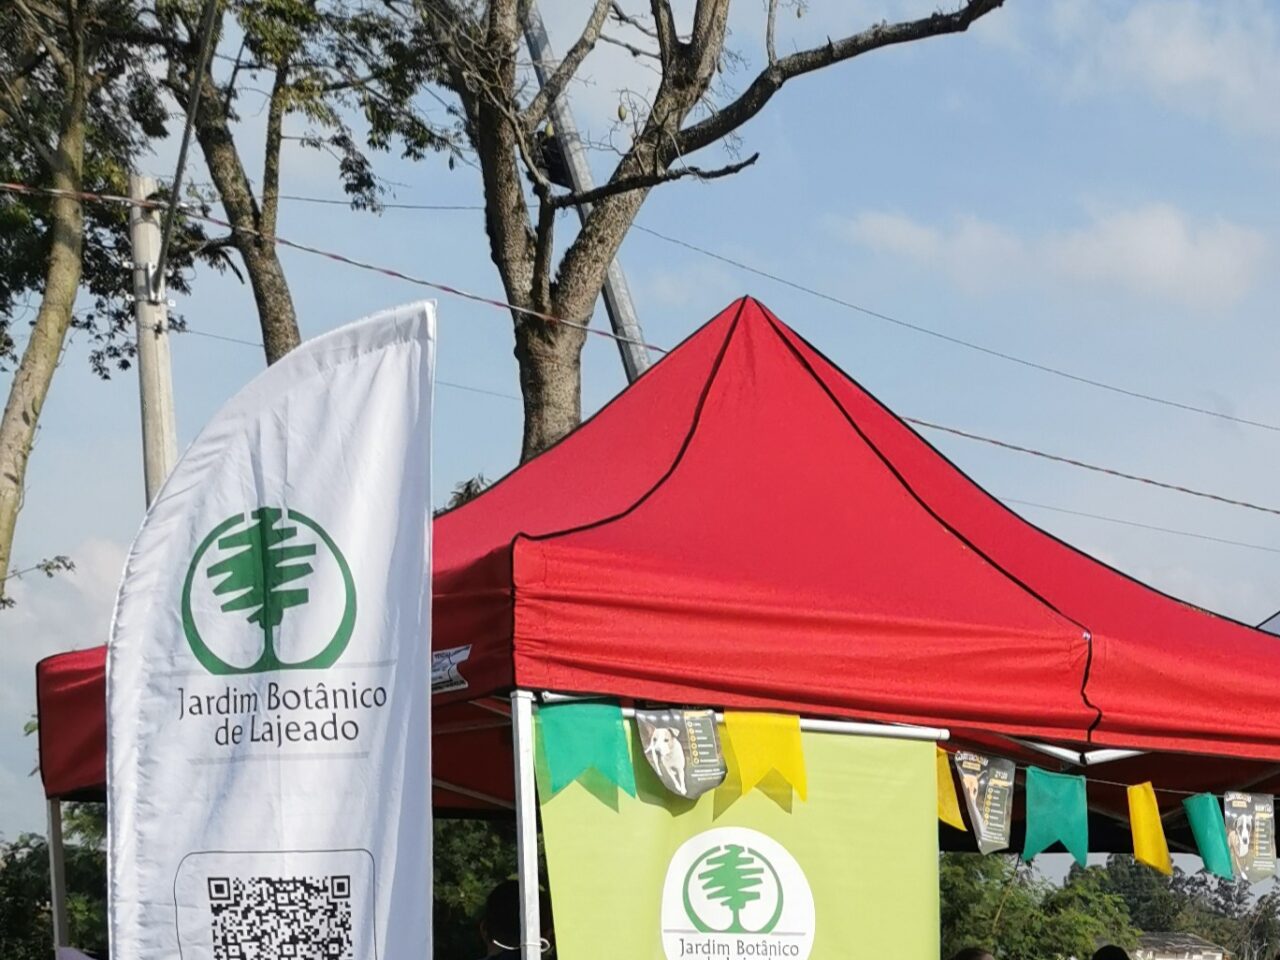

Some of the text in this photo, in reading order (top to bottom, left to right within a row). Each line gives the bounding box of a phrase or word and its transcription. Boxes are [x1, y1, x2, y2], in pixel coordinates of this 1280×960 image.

[178, 681, 388, 721] Jardim Botânico
[214, 713, 360, 748] de Lajeado
[679, 938, 800, 957] Jardim Botânico
